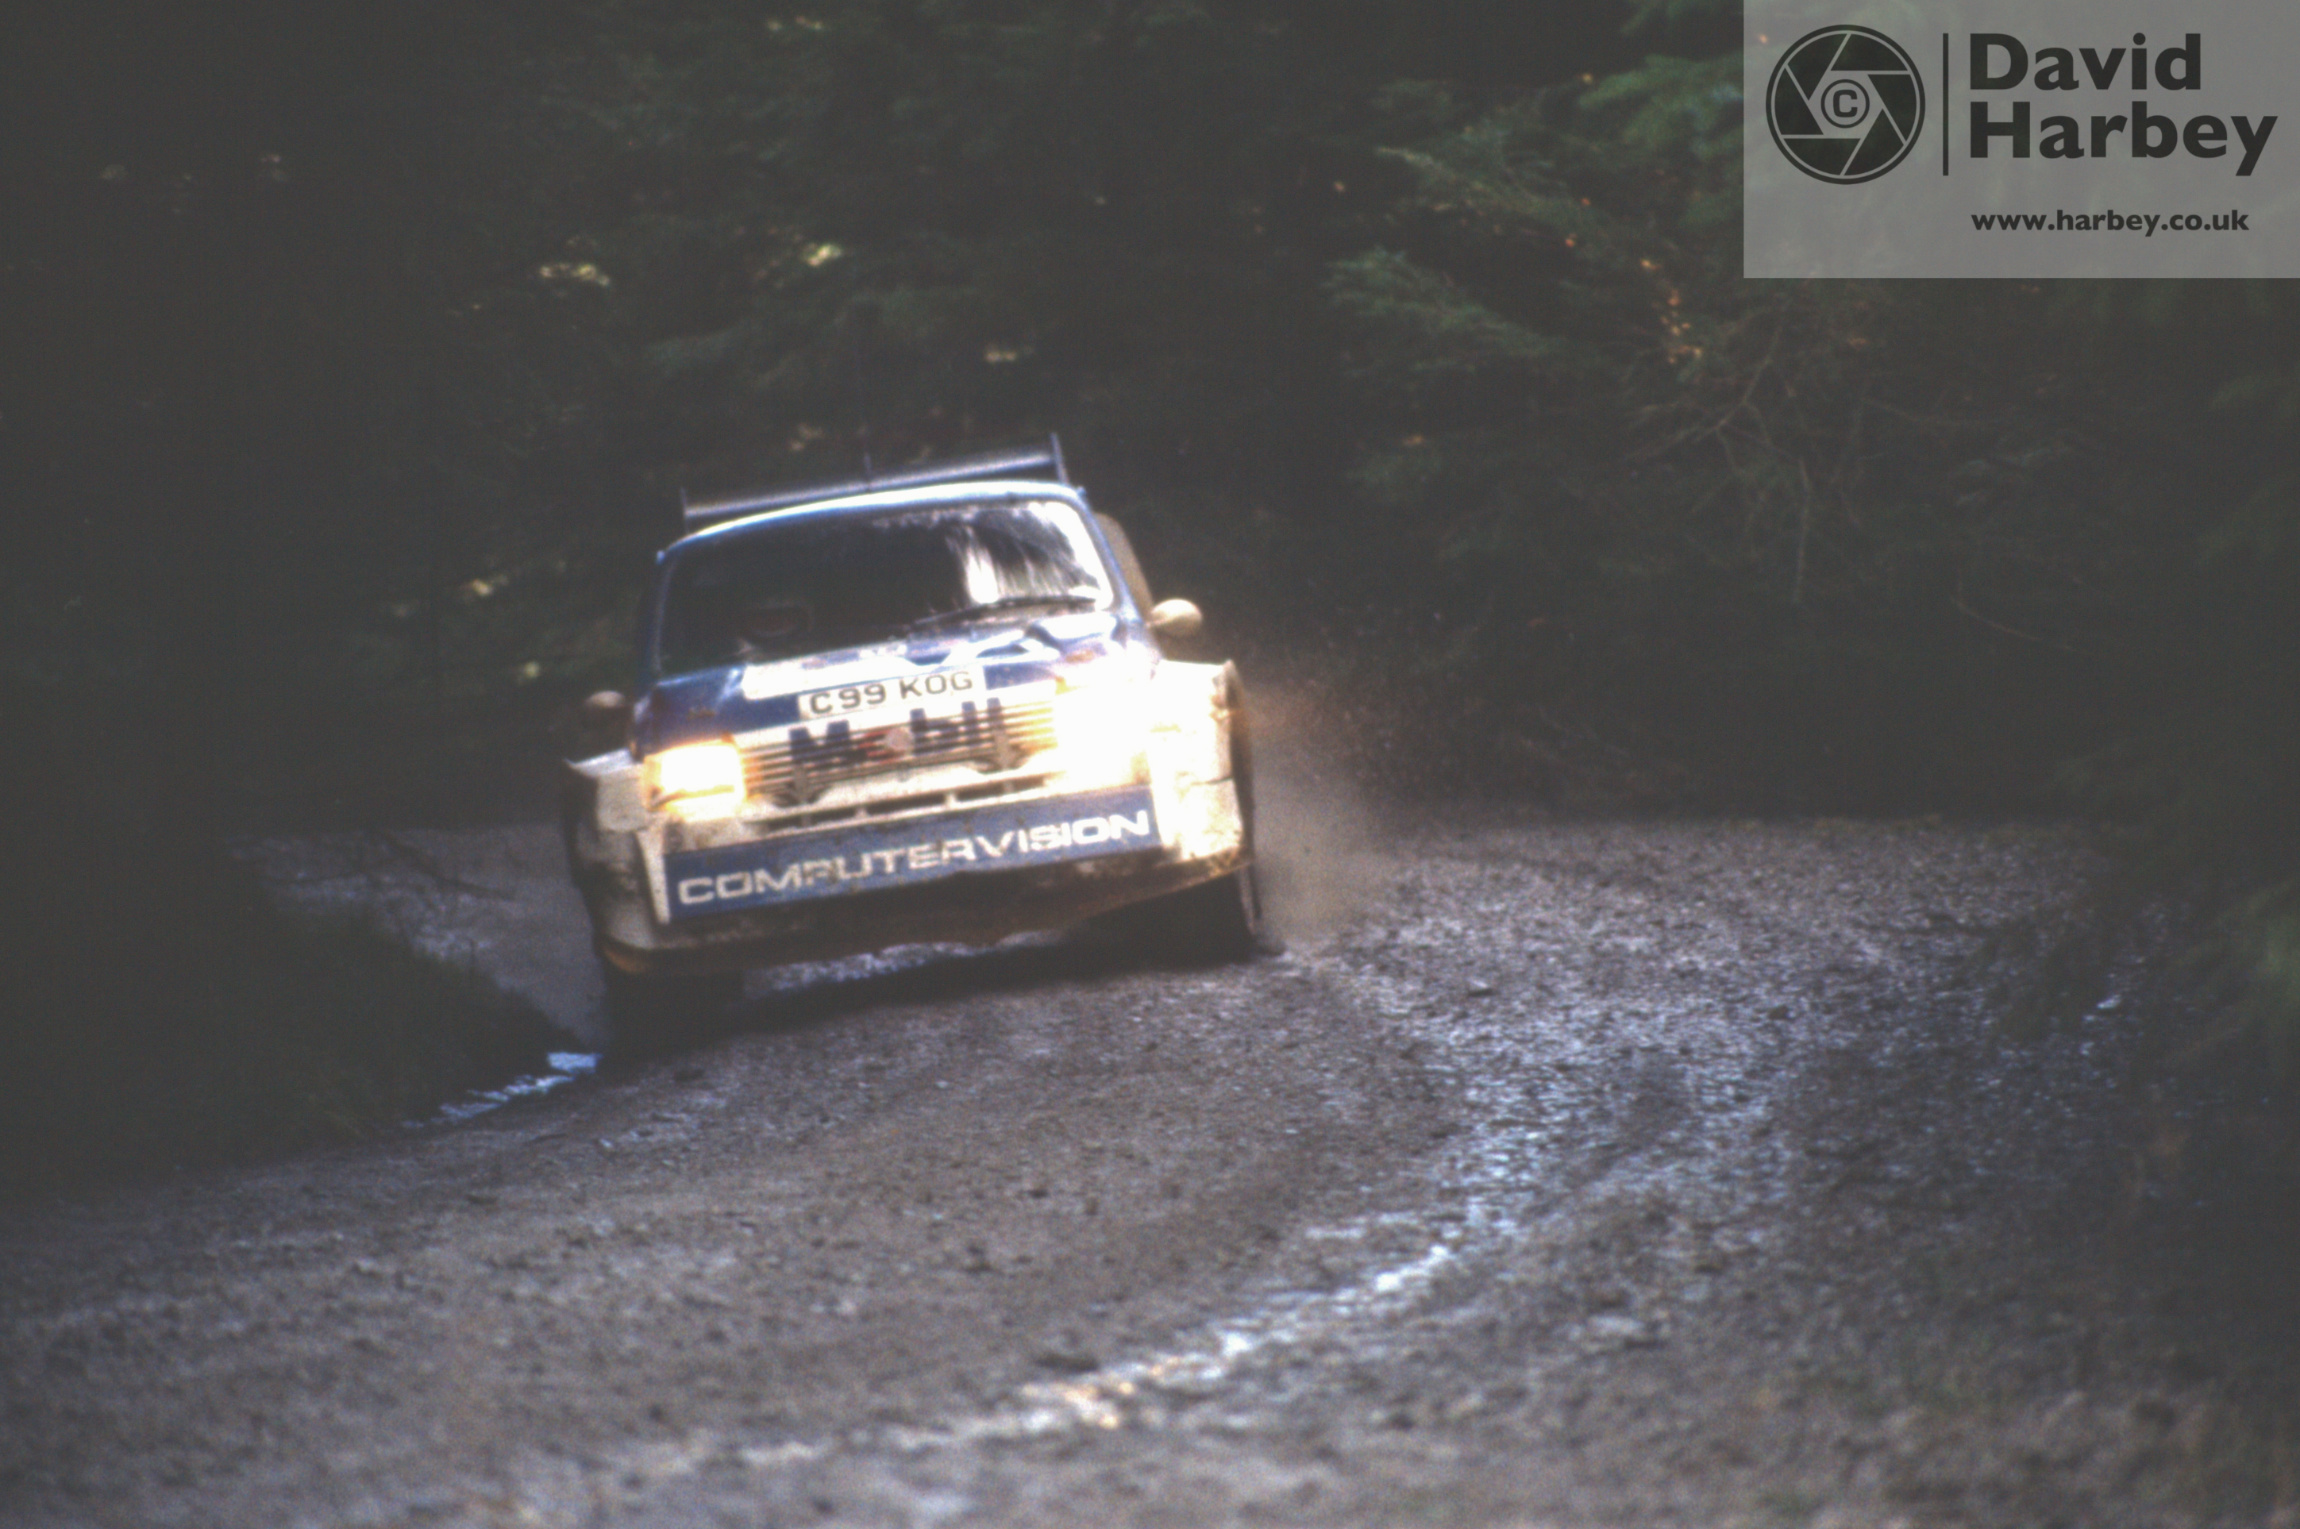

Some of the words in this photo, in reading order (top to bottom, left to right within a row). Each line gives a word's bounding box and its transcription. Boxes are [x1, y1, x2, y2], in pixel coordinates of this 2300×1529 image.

[810, 682, 887, 715] C99
[899, 670, 974, 700] KOG
[677, 809, 1150, 904] COMPUTERVISION
